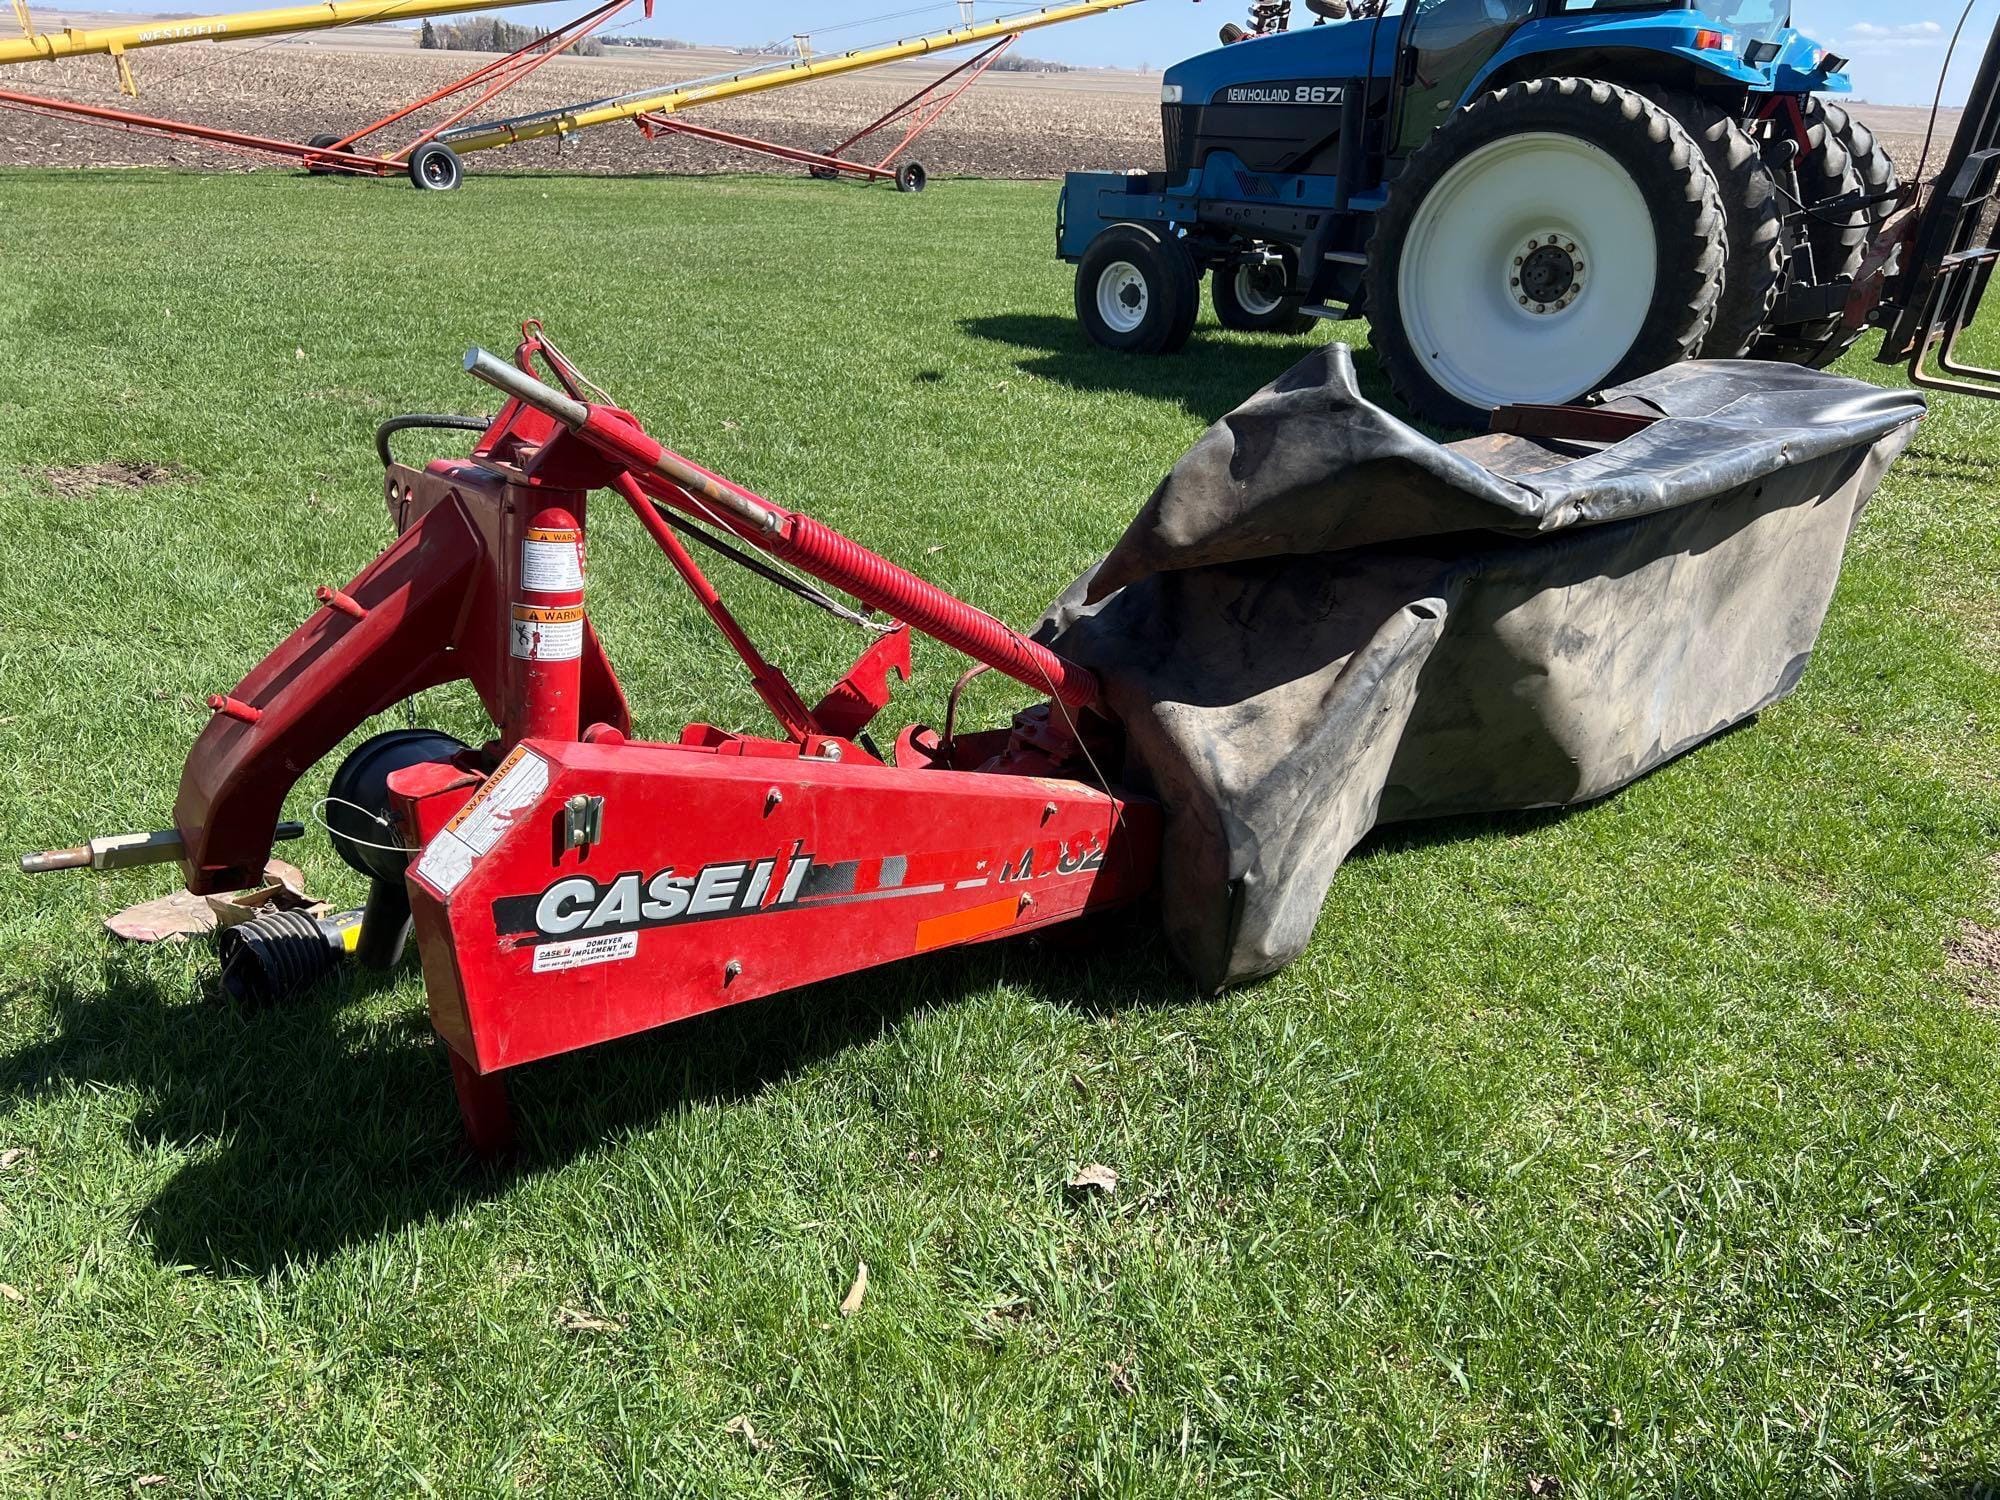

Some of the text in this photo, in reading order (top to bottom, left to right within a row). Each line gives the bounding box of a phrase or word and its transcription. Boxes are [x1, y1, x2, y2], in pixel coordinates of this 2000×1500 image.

[138, 23, 228, 42] WESTFIELD
[1227, 86, 1345, 103] NEW HOLLAND 867
[466, 757, 518, 812] WARNING
[535, 864, 746, 934] CASE
[572, 945, 618, 958] IMPLEMENT,
[620, 942, 634, 950] INC.
[586, 936, 623, 948] DOMEYER
